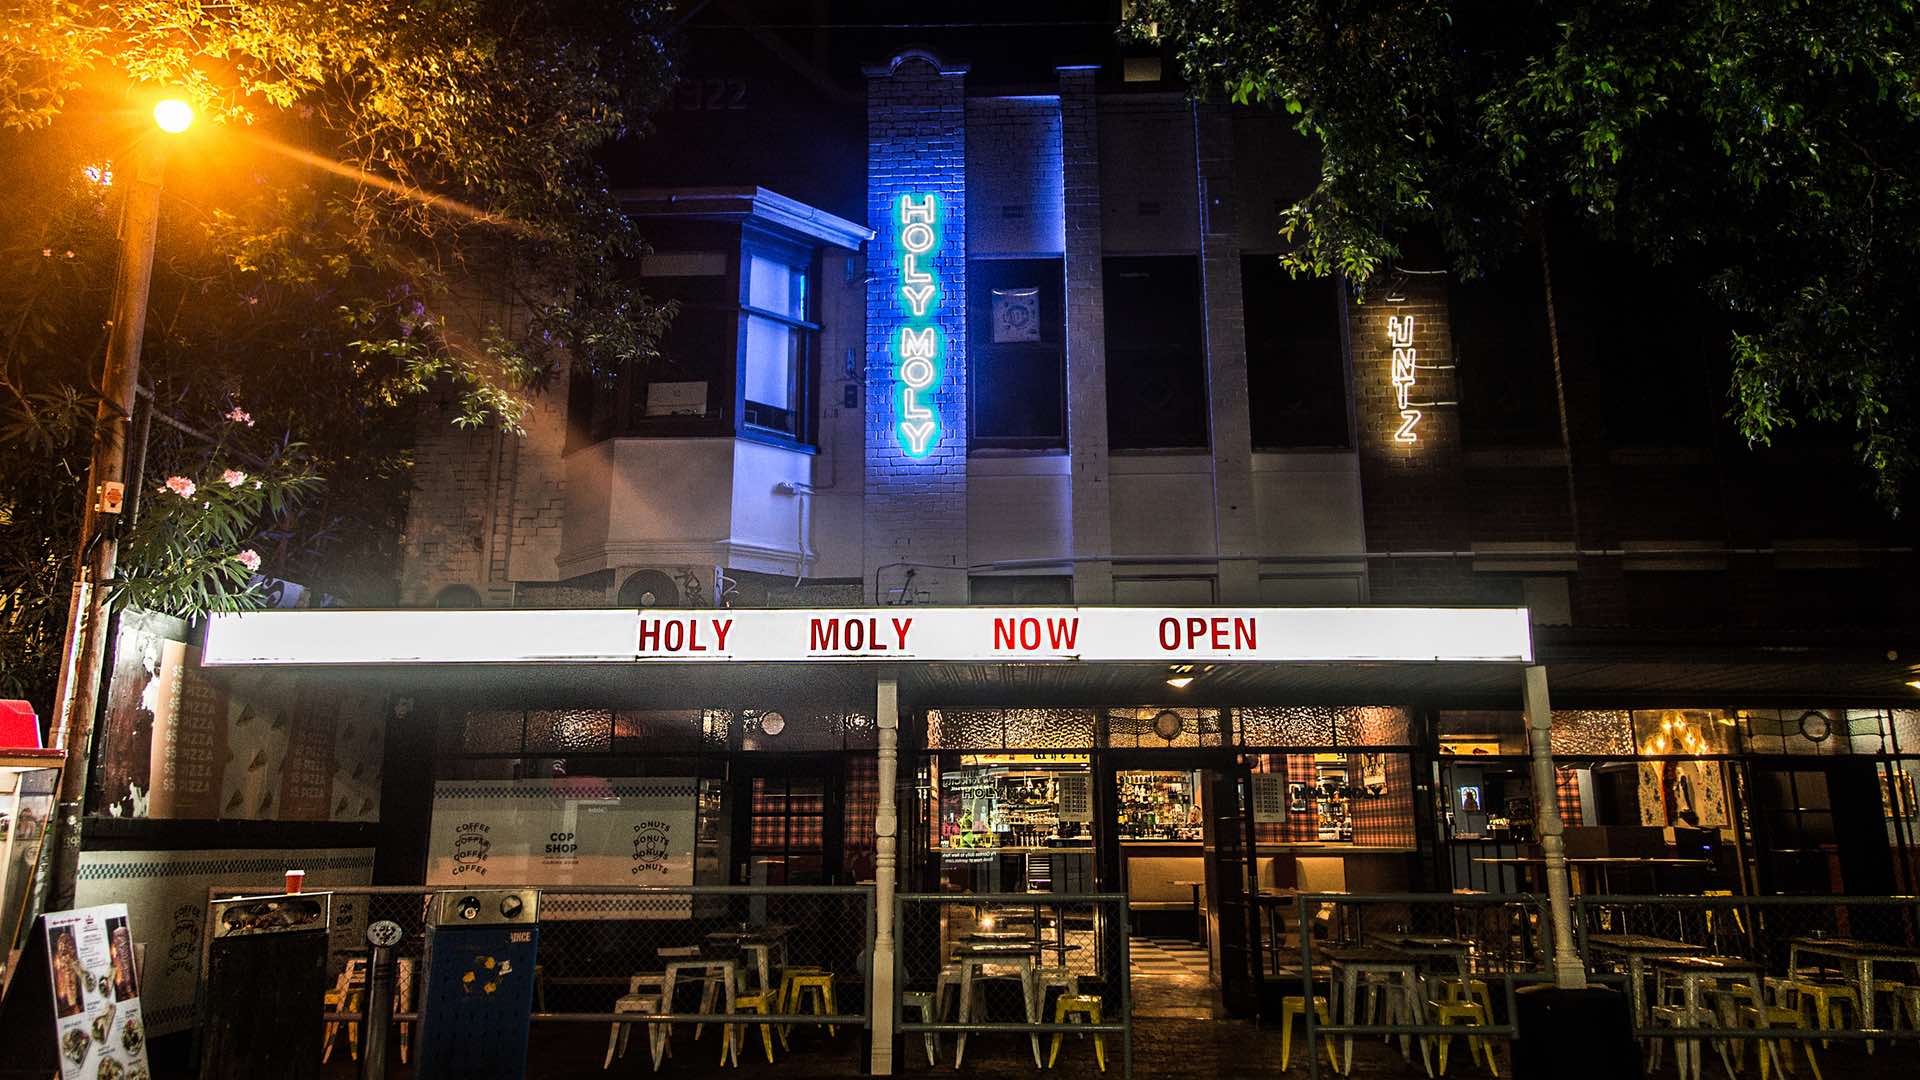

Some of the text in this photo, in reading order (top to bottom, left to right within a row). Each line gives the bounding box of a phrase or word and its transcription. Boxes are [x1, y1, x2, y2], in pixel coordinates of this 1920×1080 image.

[901, 194, 936, 454] HOLY MOLY
[641, 617, 1256, 651] HOLY MOLY NOW OPEN
[962, 787, 1003, 799] HOLY
[456, 822, 491, 834] COFFEE
[633, 820, 671, 833] DONUTS
[550, 832, 575, 842] COP
[545, 843, 578, 854] SHOP
[452, 864, 488, 877] COFFEE
[631, 863, 669, 875] DONUTS
